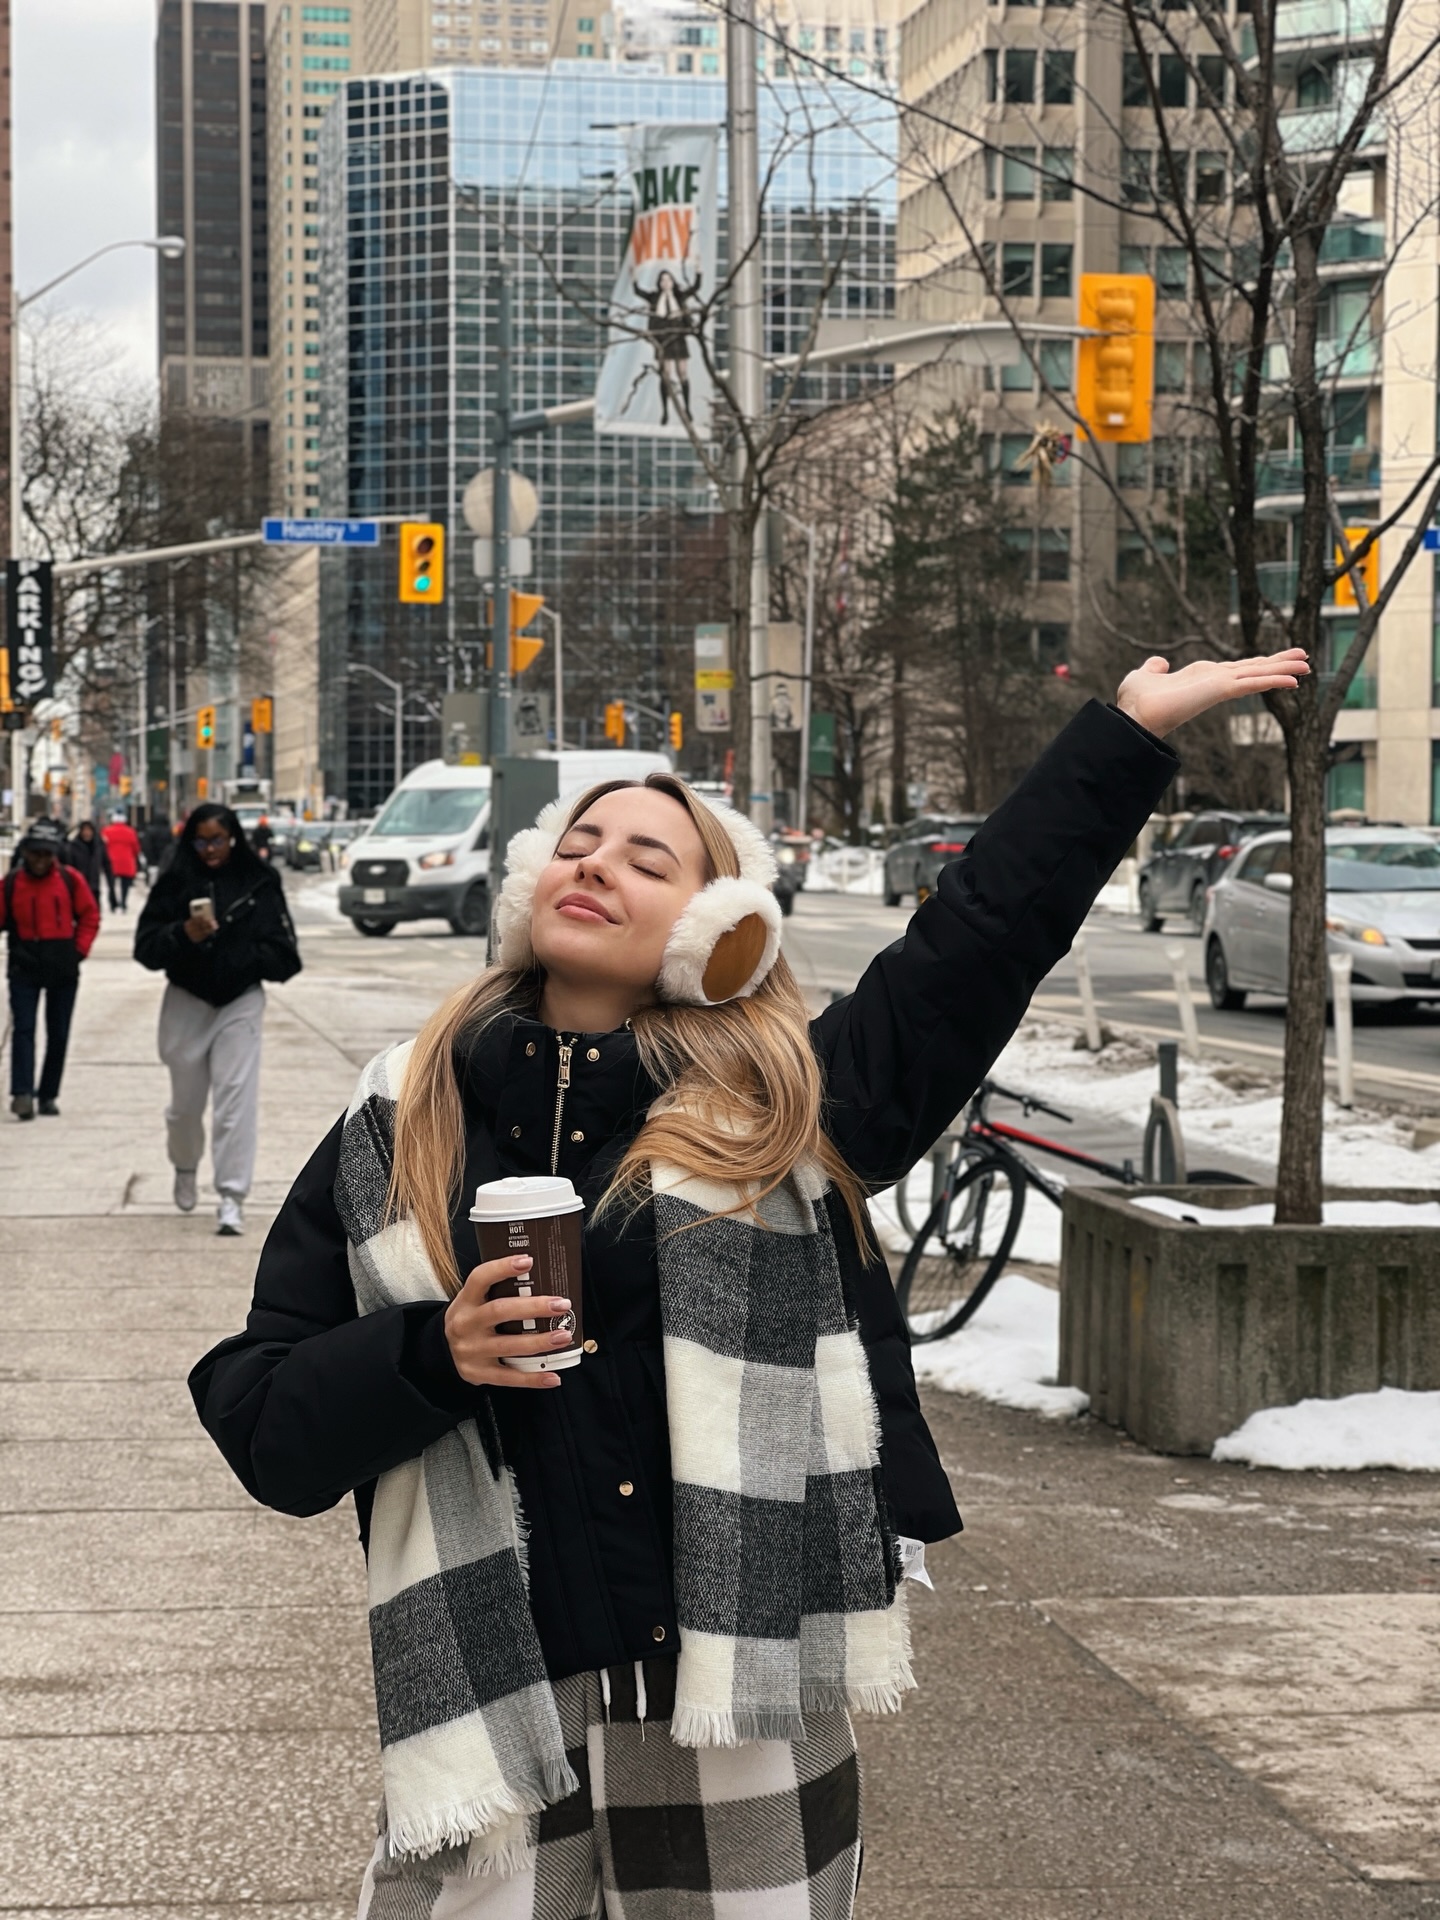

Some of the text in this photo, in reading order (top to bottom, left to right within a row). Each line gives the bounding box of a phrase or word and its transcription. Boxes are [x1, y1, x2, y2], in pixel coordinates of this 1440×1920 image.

[632, 208, 693, 266] WAY
[281, 521, 346, 541] Huntley
[16, 560, 43, 681] PARKING
[509, 1225, 525, 1234] HOT!
